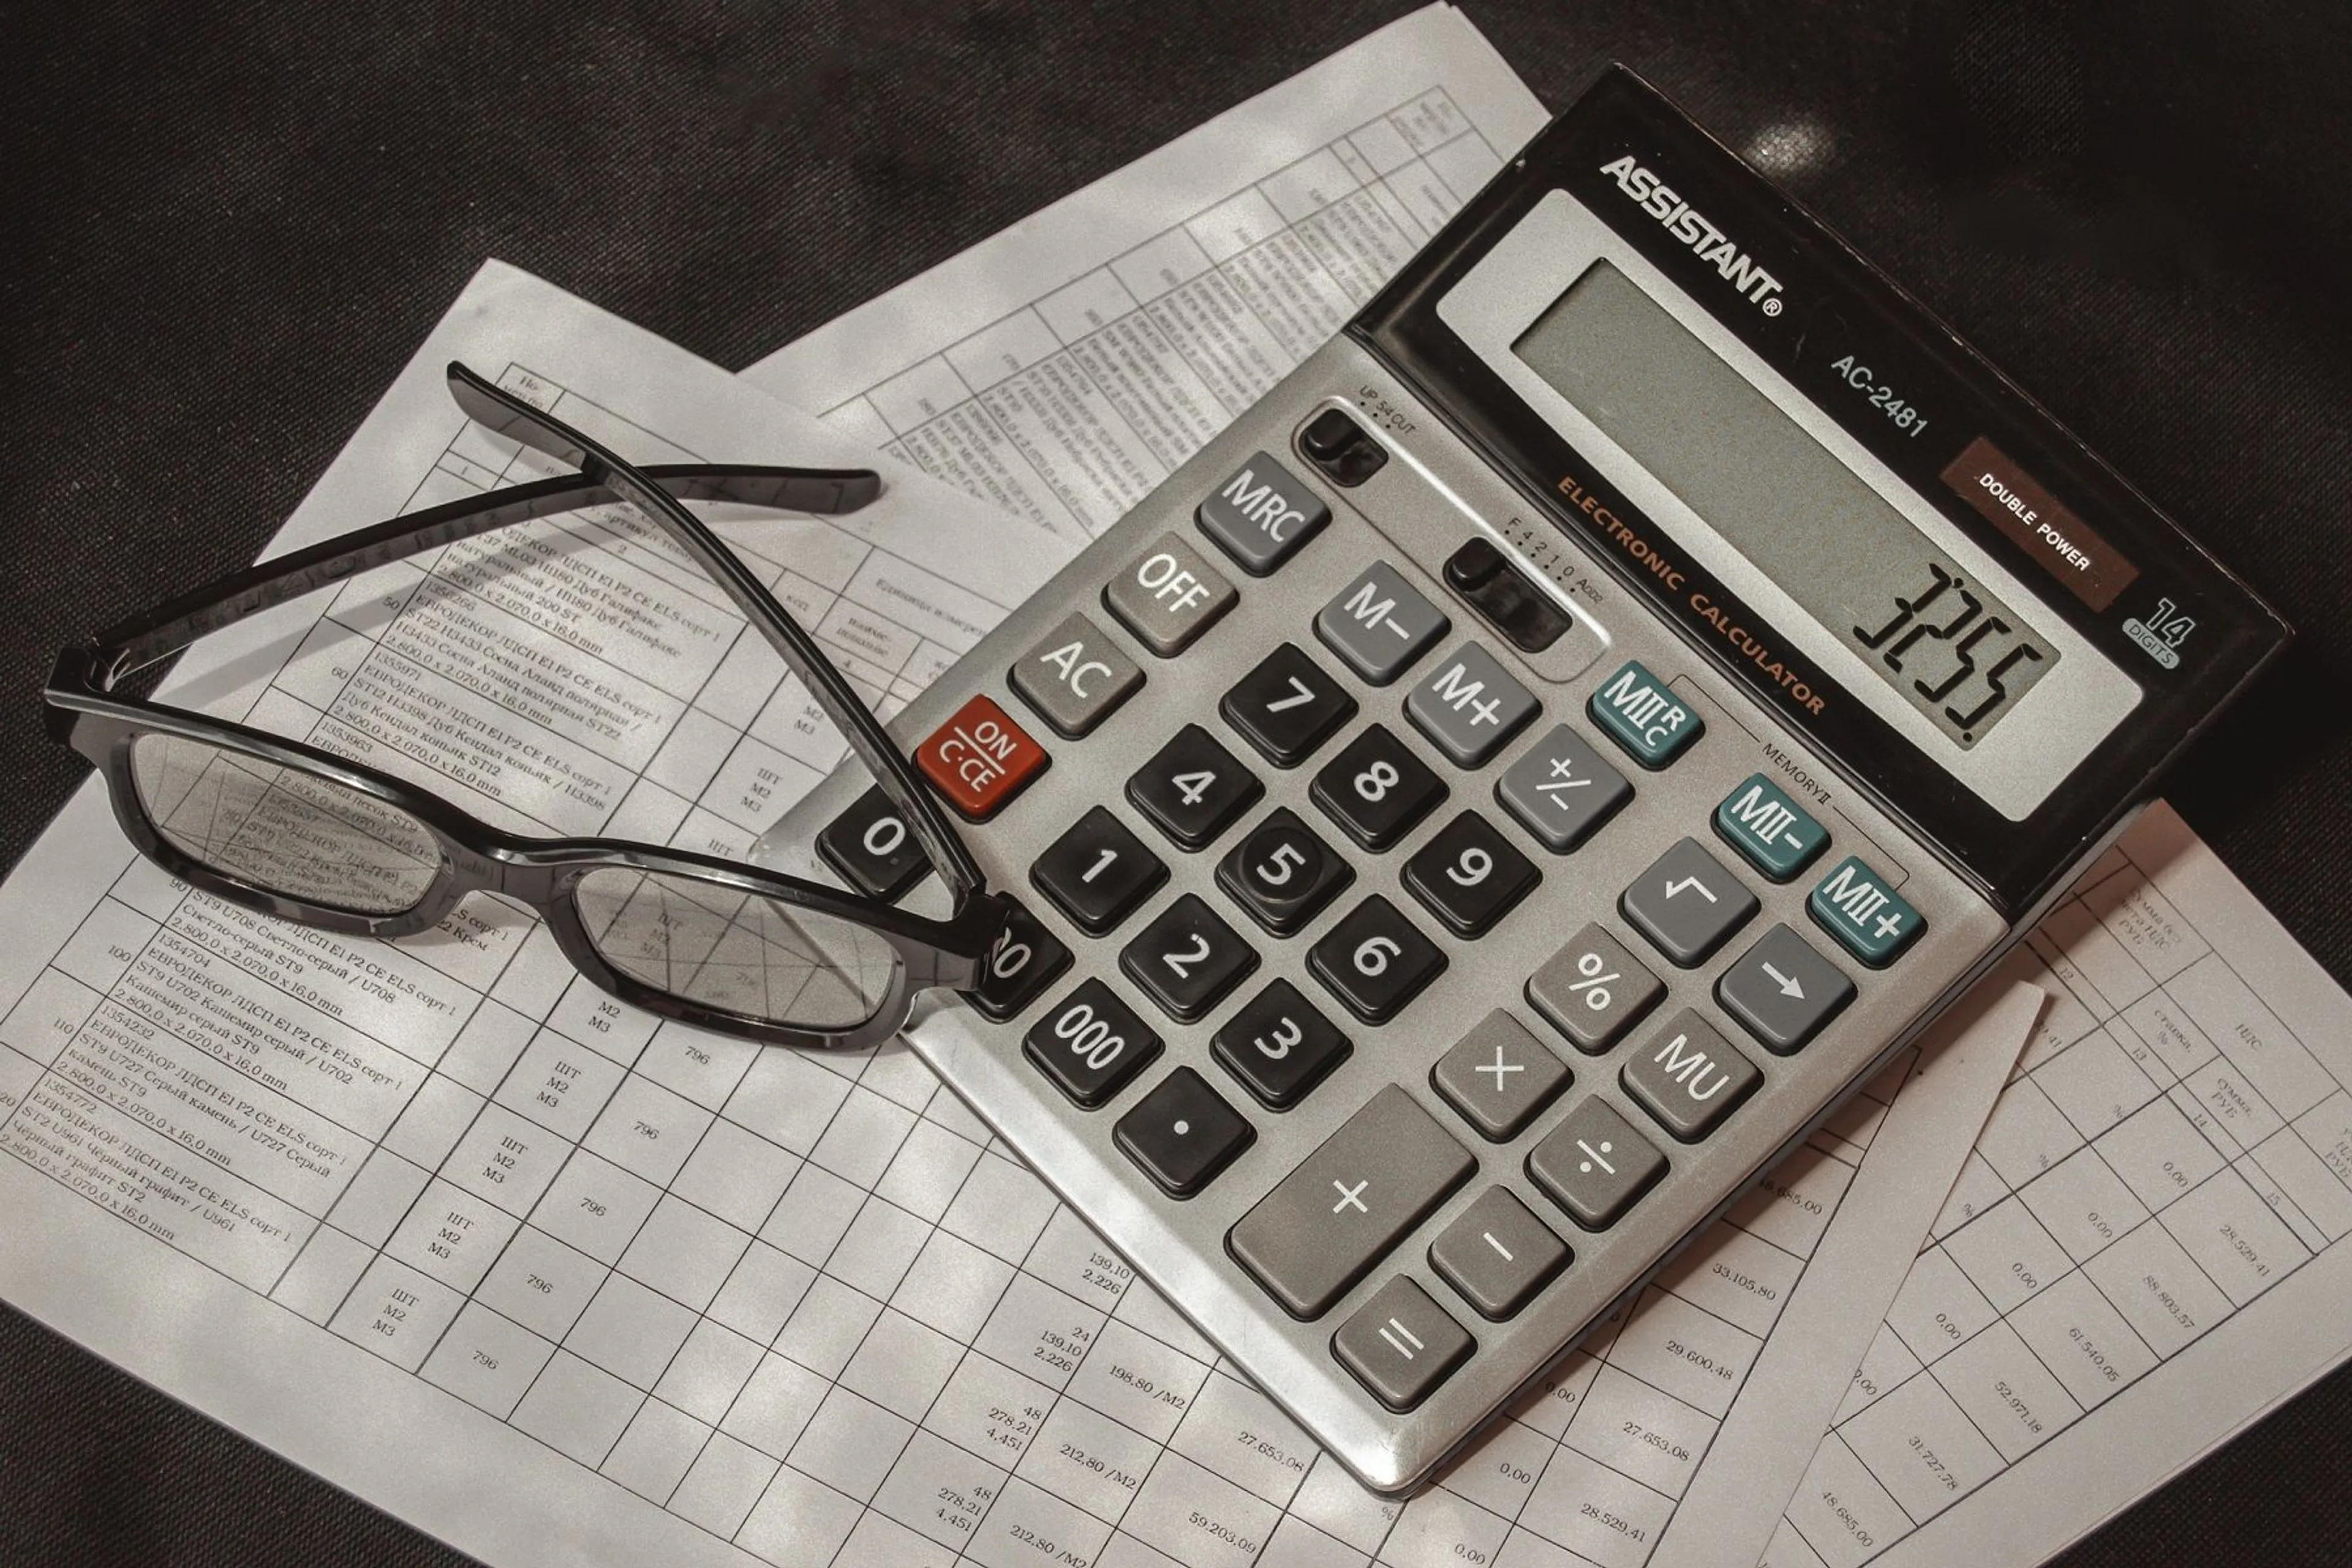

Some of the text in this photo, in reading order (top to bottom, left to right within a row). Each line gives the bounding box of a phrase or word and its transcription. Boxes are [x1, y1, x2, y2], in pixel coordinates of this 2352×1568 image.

[1831, 355, 1927, 439] AC-2481
[1391, 413, 1416, 434] CUT
[1221, 469, 1305, 541] MRC
[1980, 473, 2090, 571] DOUBLE POWER
[1535, 541, 1547, 552] 2
[1137, 554, 1210, 612] OFF
[1558, 476, 1825, 715] ELECTRONIC CALCULATOR
[383, 597, 400, 610] 50
[2146, 598, 2195, 647] 14
[2126, 622, 2175, 666] DIGITS
[331, 666, 349, 679] 60
[1040, 641, 1112, 698] AC
[1266, 677, 1315, 712] 7
[1431, 662, 1499, 727] M+
[975, 721, 1017, 760] ON
[1171, 770, 1216, 805] 4
[1354, 761, 1399, 802] 8
[863, 816, 906, 855] 0
[1082, 849, 1117, 883] 1
[1256, 843, 1306, 884] 5
[1446, 847, 1492, 886] 9
[108, 945, 131, 962] 100
[275, 955, 303, 974] ST9
[1163, 933, 1210, 978] 2
[1353, 937, 1401, 976] 6
[361, 979, 396, 1003] U708
[1569, 952, 1620, 1011] %
[137, 961, 353, 1084] ST9 U702 Кашемир серый U702
[1054, 1004, 1125, 1070] 000
[1254, 1017, 1302, 1060] 3
[232, 1035, 260, 1055] ST9
[685, 1046, 710, 1065] 796
[118, 1077, 147, 1097] ST9
[1654, 1034, 1729, 1101] MU
[109, 1050, 144, 1072] U727
[251, 1129, 287, 1152] U727
[287, 1149, 331, 1178] Серый
[634, 1121, 659, 1139] 796
[118, 1182, 146, 1203] ST2
[581, 1197, 606, 1216] 796
[527, 1274, 553, 1293] 796
[1072, 1327, 1089, 1341] 24
[473, 1350, 499, 1370] 796
[1023, 1408, 1042, 1419] 48
[974, 1487, 992, 1500] 48
